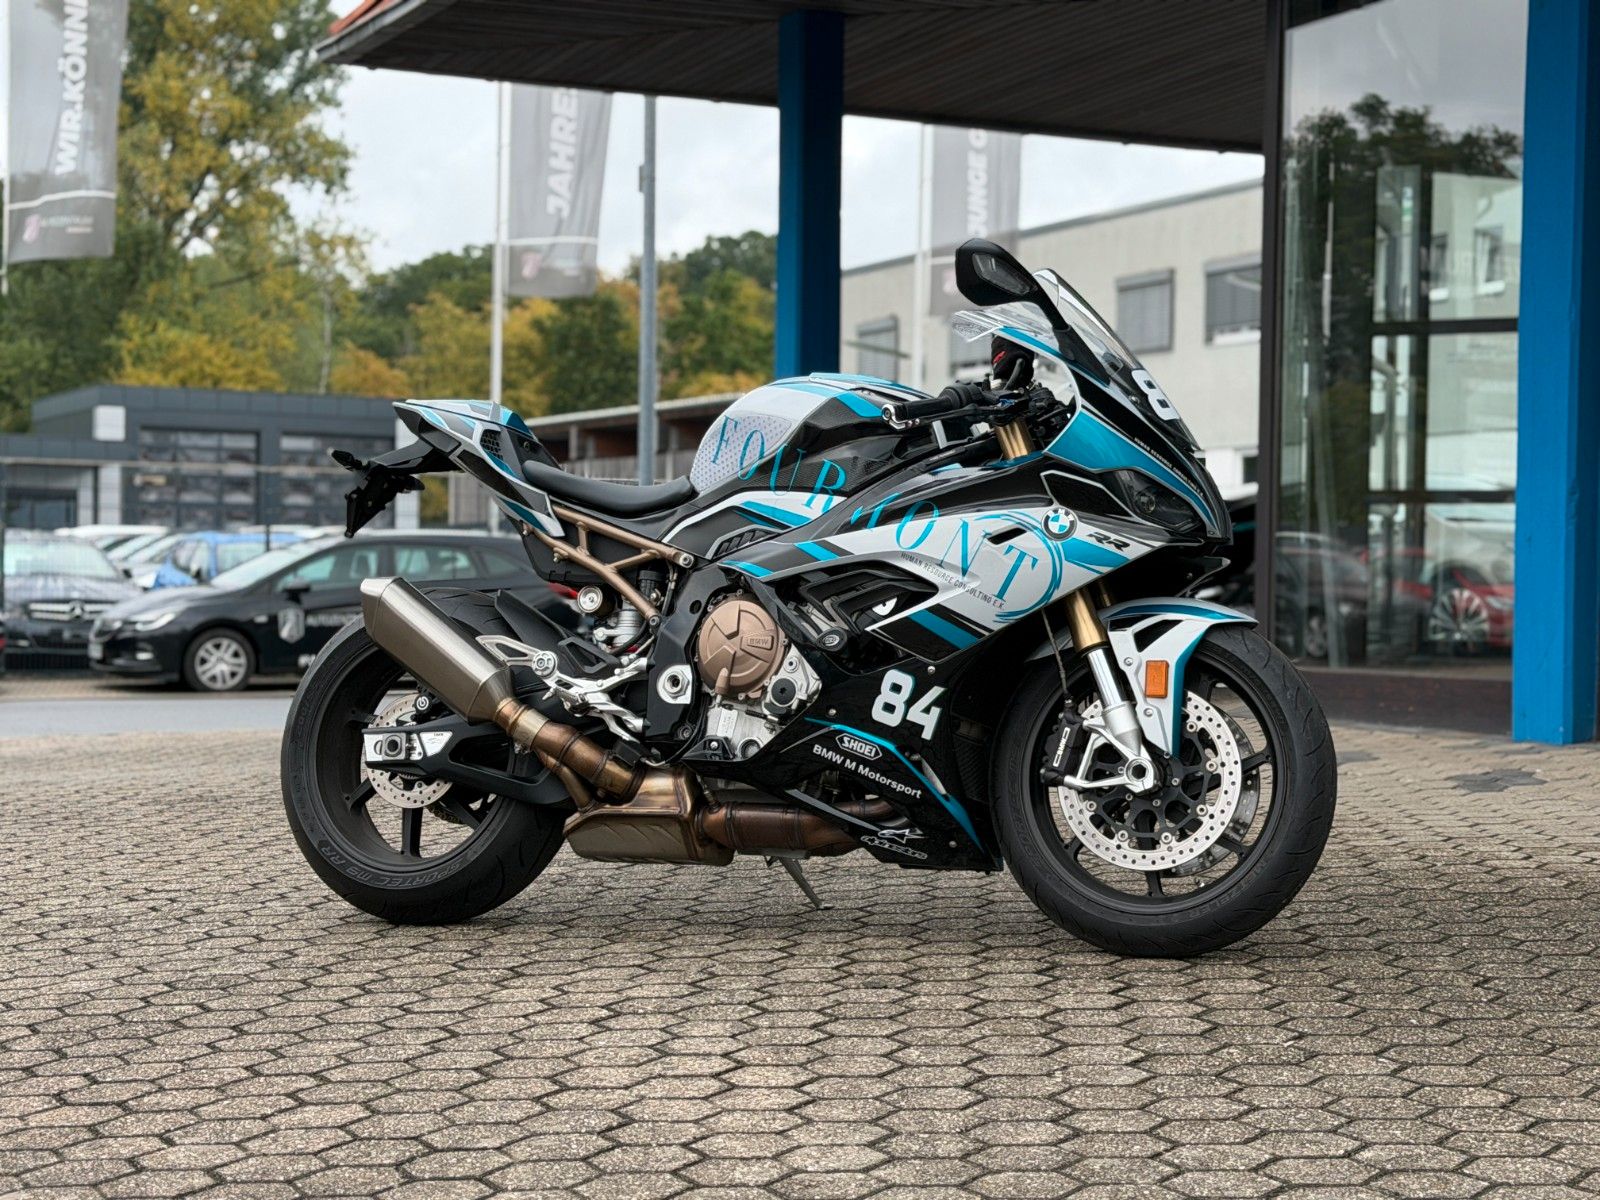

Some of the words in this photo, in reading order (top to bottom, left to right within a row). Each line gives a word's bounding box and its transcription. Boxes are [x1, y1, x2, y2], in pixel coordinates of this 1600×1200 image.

[55, 0, 89, 176] WIR.KÖNN
[1086, 531, 1131, 552] RR
[901, 552, 923, 567] HUMAN
[923, 563, 955, 584] RESOURCE
[871, 668, 949, 741] 84
[842, 736, 877, 758] SHOEI
[812, 744, 844, 765] BMW
[844, 759, 857, 771] M
[857, 764, 922, 799] Motorsport
